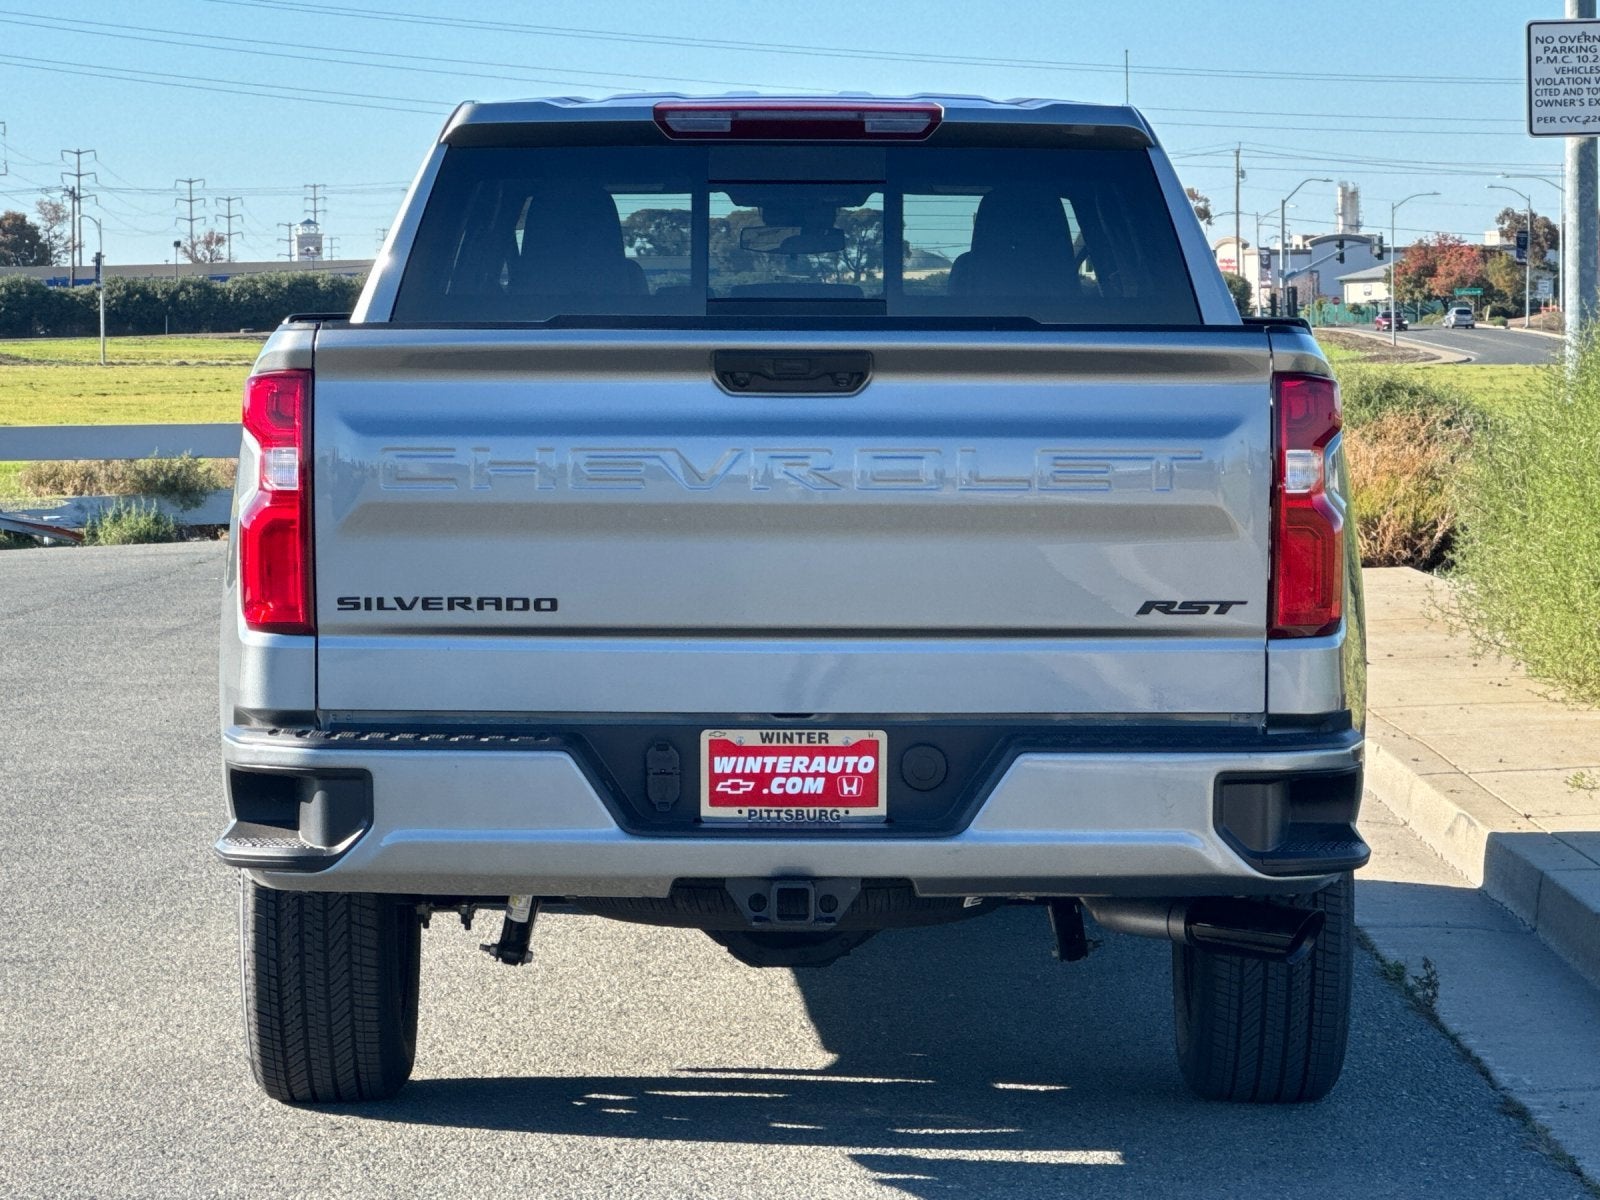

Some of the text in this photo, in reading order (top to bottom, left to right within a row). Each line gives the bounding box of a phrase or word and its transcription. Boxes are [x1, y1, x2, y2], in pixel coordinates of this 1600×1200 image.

[1535, 35, 1600, 44] NO OVERN
[1543, 45, 1598, 54] PARKING
[1535, 55, 1573, 65] P.M.C.
[1554, 66, 1600, 75] VEHICLES
[1534, 77, 1592, 86] VIOLATION
[1534, 87, 1600, 97] CITED AND TO
[1534, 98, 1585, 107] OWNER'S
[1536, 116, 1557, 124] PER
[380, 446, 1203, 493] CHEVROLET
[336, 596, 559, 612] SILVERADO
[1135, 600, 1248, 615] RST
[760, 731, 830, 745] WINTER
[713, 755, 876, 774] WINTERAUTO
[762, 776, 826, 795] .COM
[747, 808, 841, 822] PITTSBURG
